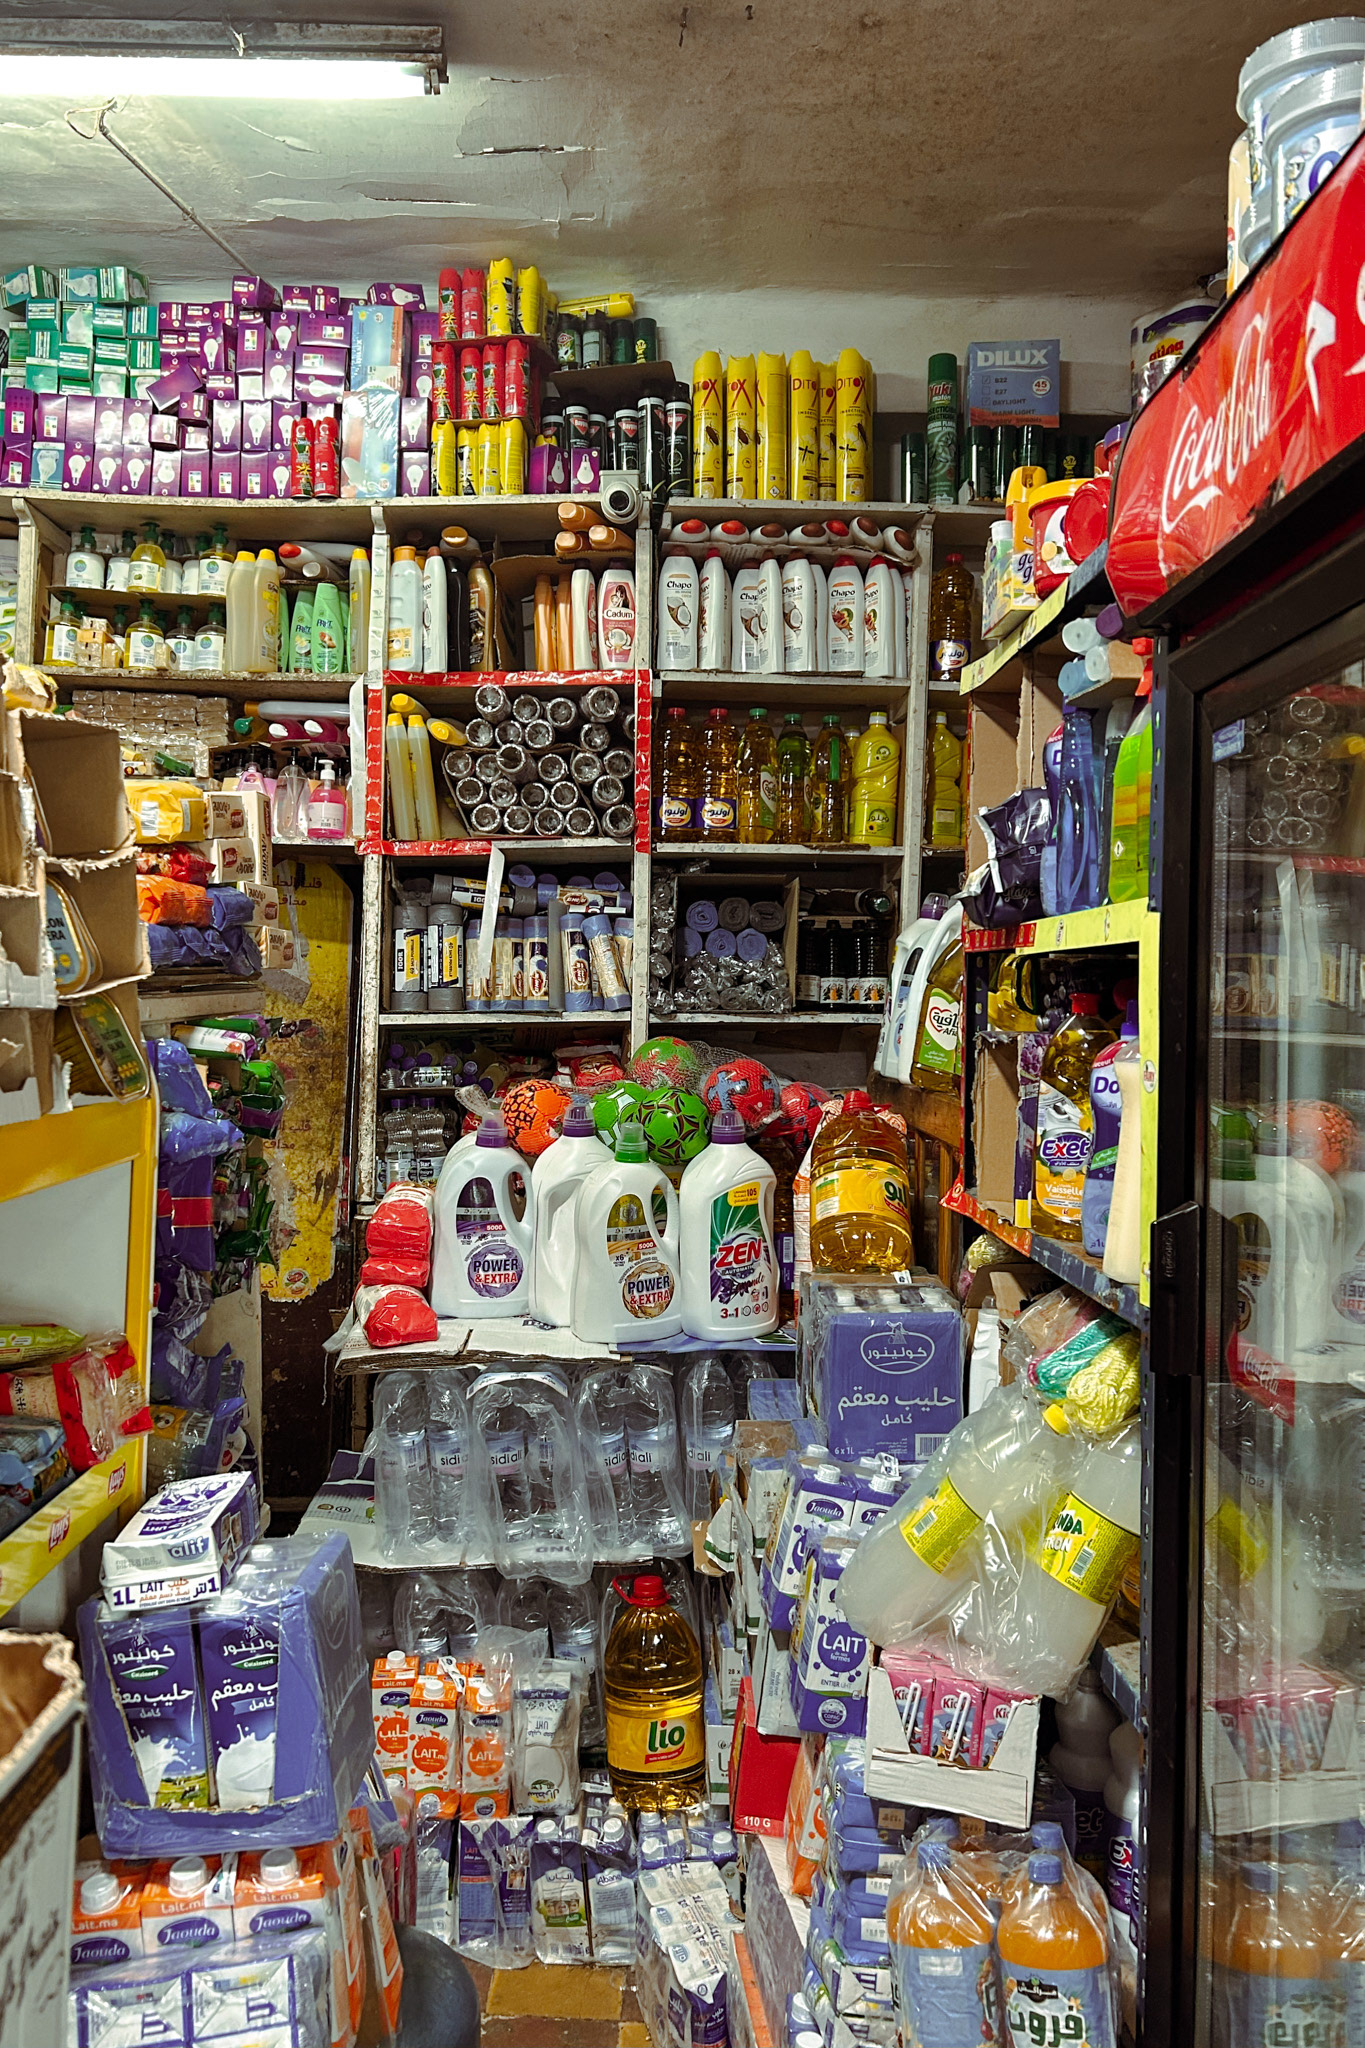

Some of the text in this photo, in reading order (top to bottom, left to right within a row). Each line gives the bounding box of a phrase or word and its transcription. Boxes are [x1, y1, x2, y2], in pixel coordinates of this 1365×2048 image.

[977, 349, 1048, 367] DILUX
[1034, 380, 1048, 388] 45
[666, 581, 692, 590] Chapo
[740, 592, 758, 601] Chap
[831, 589, 856, 598] Chapo
[606, 609, 633, 619] Cadum
[1041, 1139, 1080, 1158] Exet
[747, 1187, 757, 1196] 105
[638, 1241, 654, 1250] 5000
[715, 1239, 762, 1269] ZEN
[473, 1258, 518, 1273] POWER
[627, 1275, 671, 1295] POWER
[867, 1346, 928, 1360] كولينور
[837, 1385, 957, 1421] حليب معقم
[881, 1413, 913, 1427] كامل
[639, 1450, 653, 1464] ali
[697, 1450, 711, 1463] ali
[834, 1447, 841, 1455] 6
[846, 1447, 855, 1455] 1L
[440, 1452, 461, 1466] sidi
[490, 1453, 508, 1466] sidi
[808, 1501, 844, 1518] Jaouda
[170, 1536, 204, 1558] alif
[113, 1586, 136, 1606] 1L
[140, 1580, 165, 1594] LAIT
[821, 1631, 864, 1653] LAIT
[112, 1644, 176, 1665] كولينور
[820, 1678, 840, 1688] ENTIER
[143, 1682, 194, 1707] حليب
[211, 1678, 255, 1711] معقم
[248, 1696, 275, 1712] كامل
[419, 1700, 445, 1709] Lait.ma
[139, 1708, 162, 1719] كامل
[418, 1713, 447, 1724] Jaouda
[648, 1719, 686, 1753] lio
[743, 1815, 771, 1828] 110 G
[256, 1912, 309, 1932] Jaouda
[163, 1923, 217, 1943] Jaouda
[73, 1945, 127, 1963] Jaouda
